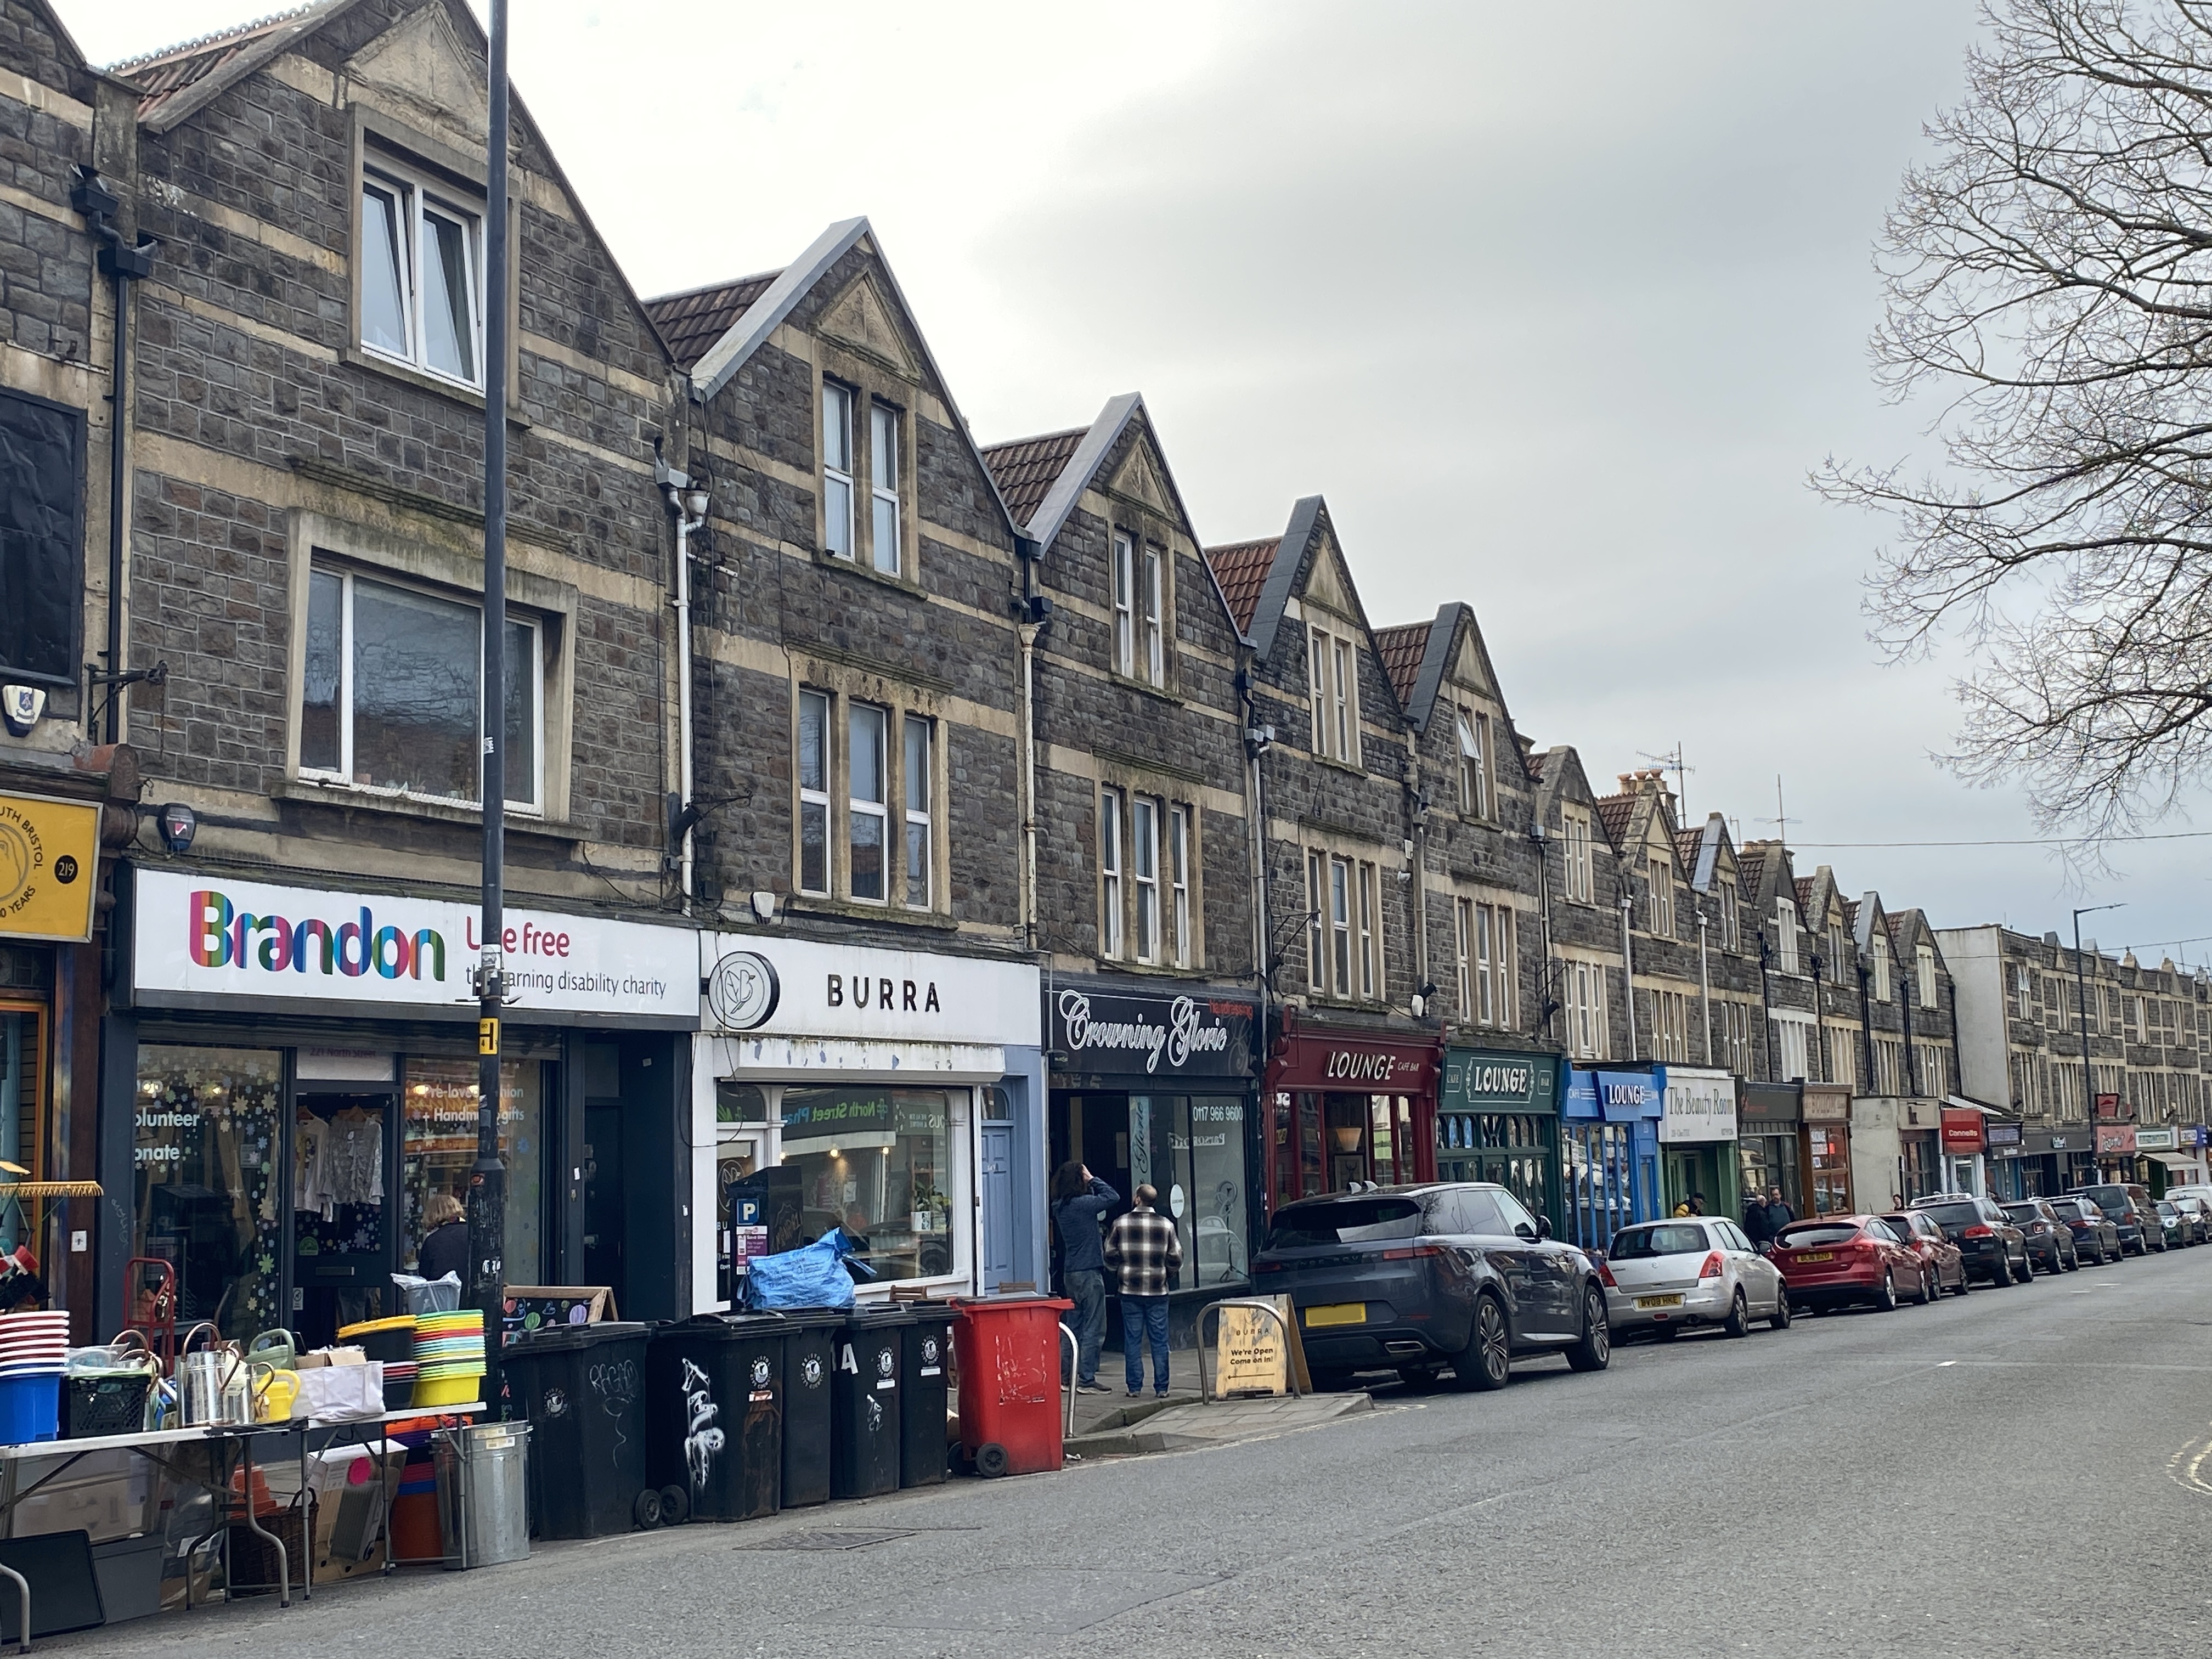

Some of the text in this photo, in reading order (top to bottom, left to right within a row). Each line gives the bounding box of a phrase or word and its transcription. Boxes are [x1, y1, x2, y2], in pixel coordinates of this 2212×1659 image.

[21, 820, 43, 870] BRISTOL
[58, 862, 75, 876] 219
[8, 885, 36, 914] YEARS
[190, 891, 445, 981] Brandon
[466, 916, 570, 957] Le free
[509, 969, 667, 1000] arning disability charity
[827, 974, 940, 1013] BURRA
[1059, 989, 1227, 1074] Crowning Glorie
[1328, 1051, 1396, 1080] LOUNGE
[1474, 1066, 1527, 1093] LOUNGE
[500, 1083, 523, 1098] hion
[1541, 1077, 1550, 1087] BAR
[1609, 1084, 1646, 1104] LOUNGE
[136, 1107, 200, 1126] olunteer
[434, 1107, 479, 1121] Handm
[504, 1105, 524, 1125] gifts
[1193, 1106, 1243, 1121] 0117 966 9600
[1668, 1087, 1734, 1126] The Beauty Room
[135, 1144, 180, 1161] onate
[743, 1203, 755, 1220] P
[841, 1343, 859, 1375] A
